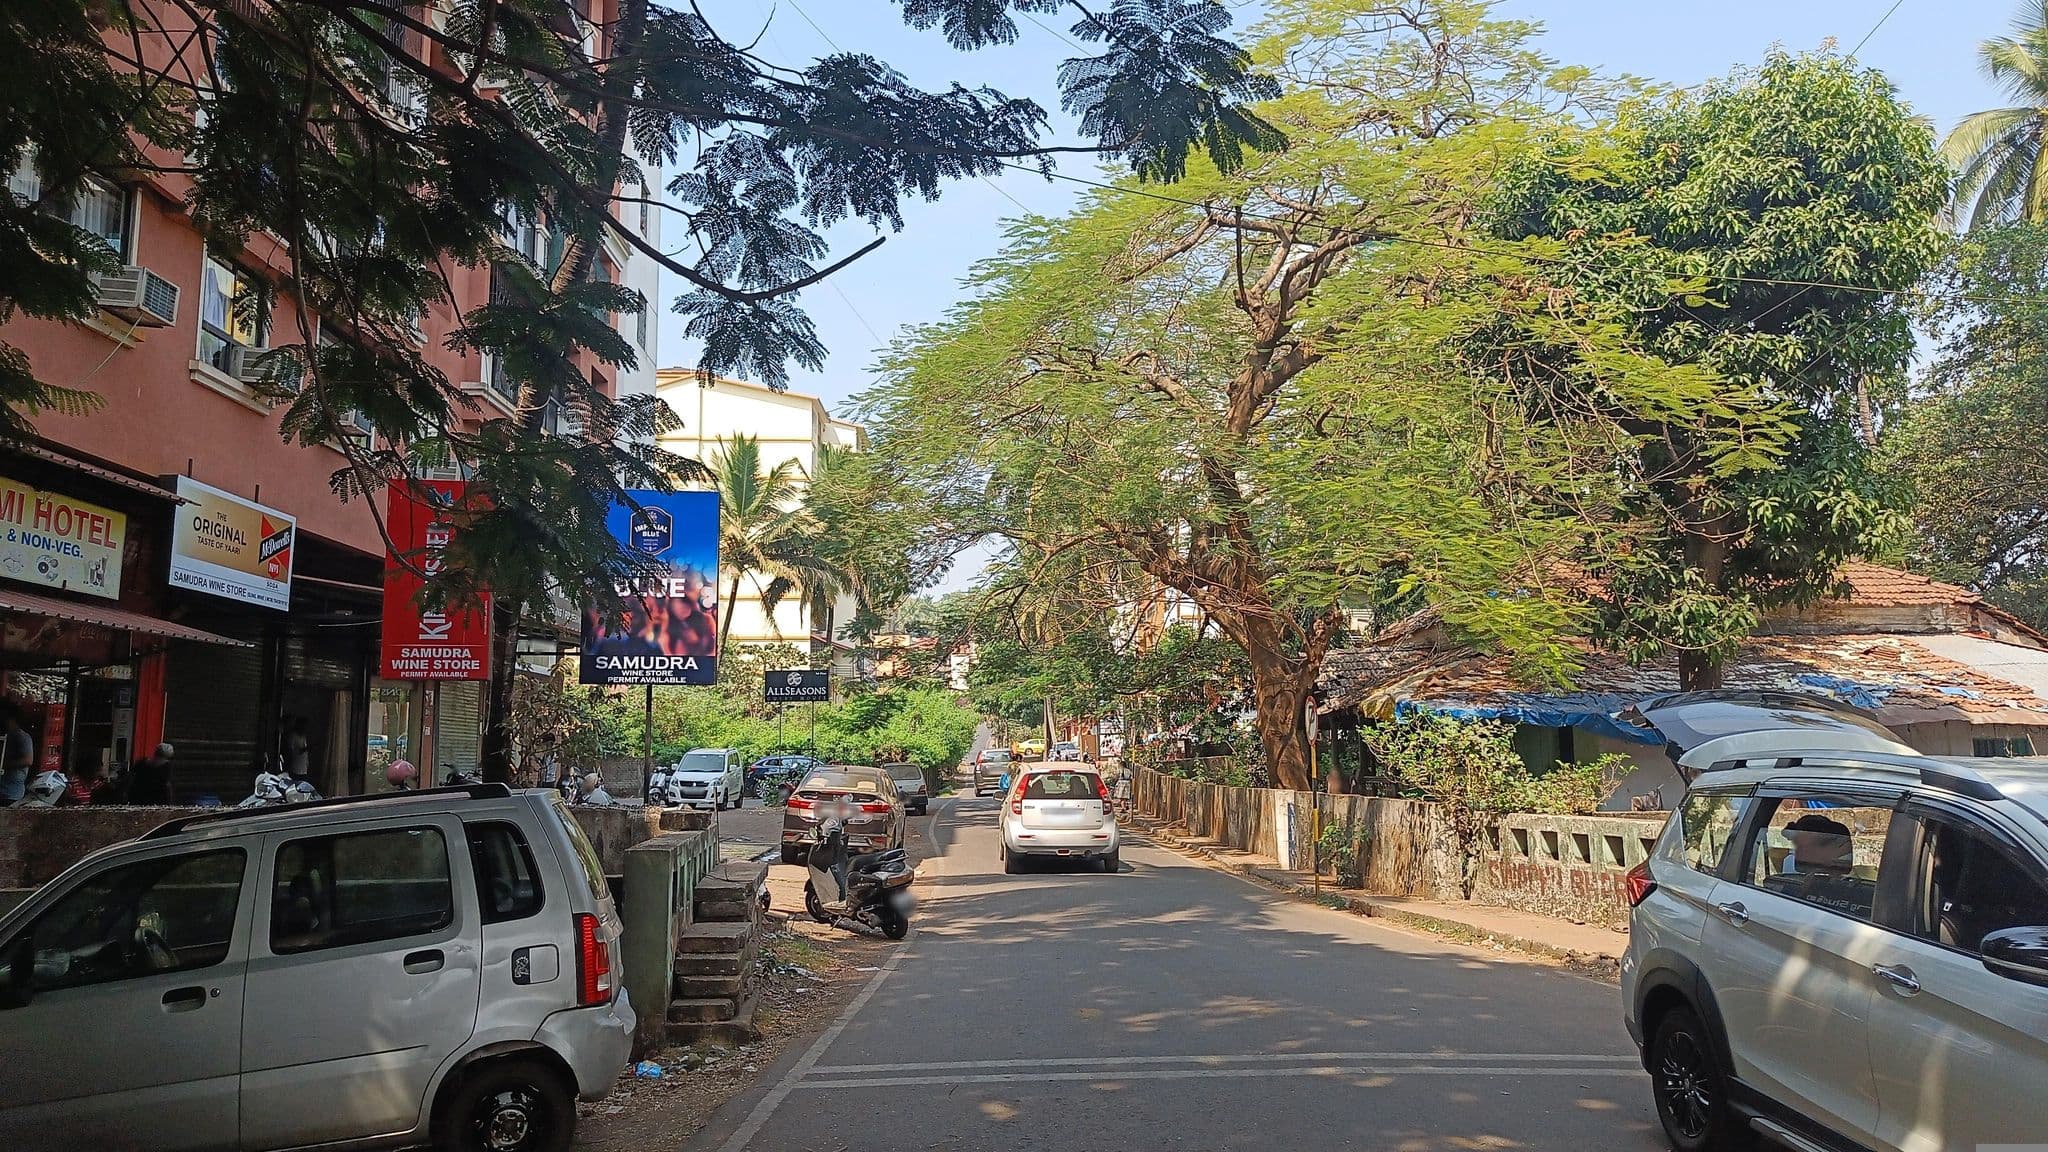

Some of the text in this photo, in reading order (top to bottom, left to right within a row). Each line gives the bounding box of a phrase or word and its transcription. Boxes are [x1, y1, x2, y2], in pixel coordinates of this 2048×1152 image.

[33, 496, 117, 549] HOTEL
[216, 511, 228, 522] THE
[193, 516, 247, 546] ORIGINAL
[7, 528, 84, 559] & NON-VEG.
[197, 535, 214, 549] TASTE
[215, 540, 224, 550] OF
[173, 571, 247, 598] SAMUDRA WINE STORE
[400, 648, 472, 658] SAMUDRA
[391, 659, 480, 670] WINE STORE
[595, 655, 699, 670] SAMUDRA
